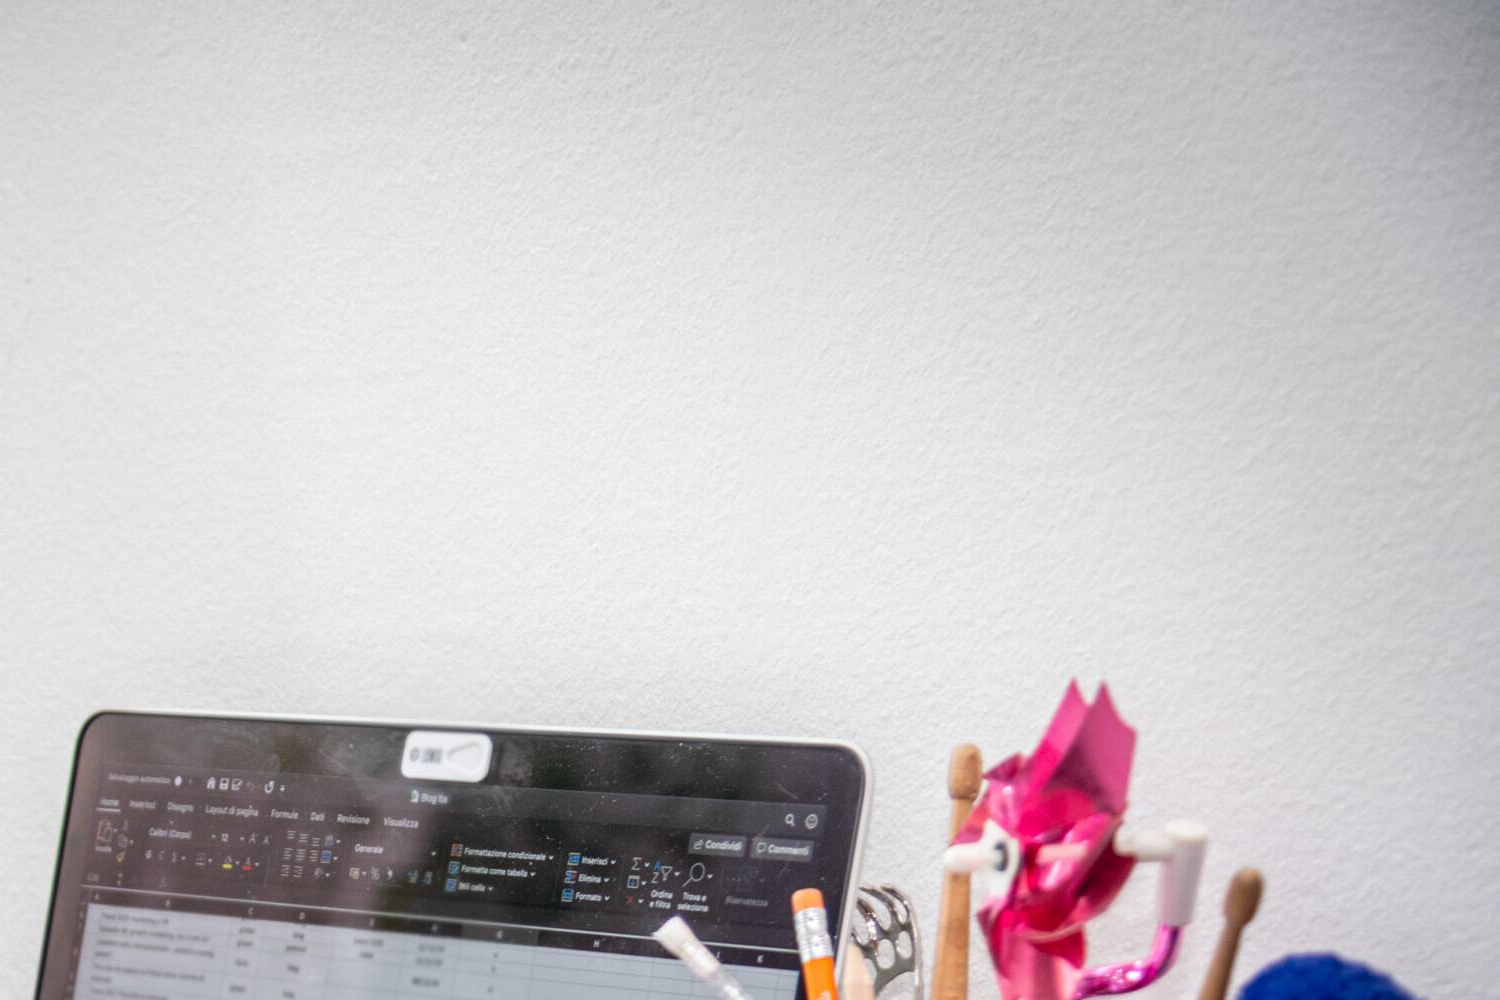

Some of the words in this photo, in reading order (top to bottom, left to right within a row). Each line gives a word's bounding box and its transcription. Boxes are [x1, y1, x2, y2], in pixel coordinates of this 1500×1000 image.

[705, 839, 742, 851] Condividi
[768, 844, 809, 855] Commenti
[464, 848, 506, 858] Formattazione
[582, 856, 608, 866] Inserisci
[579, 874, 601, 884] Elimina
[575, 892, 602, 901] Formato
[651, 890, 673, 899] Ordina
[683, 892, 701, 901] Trova
